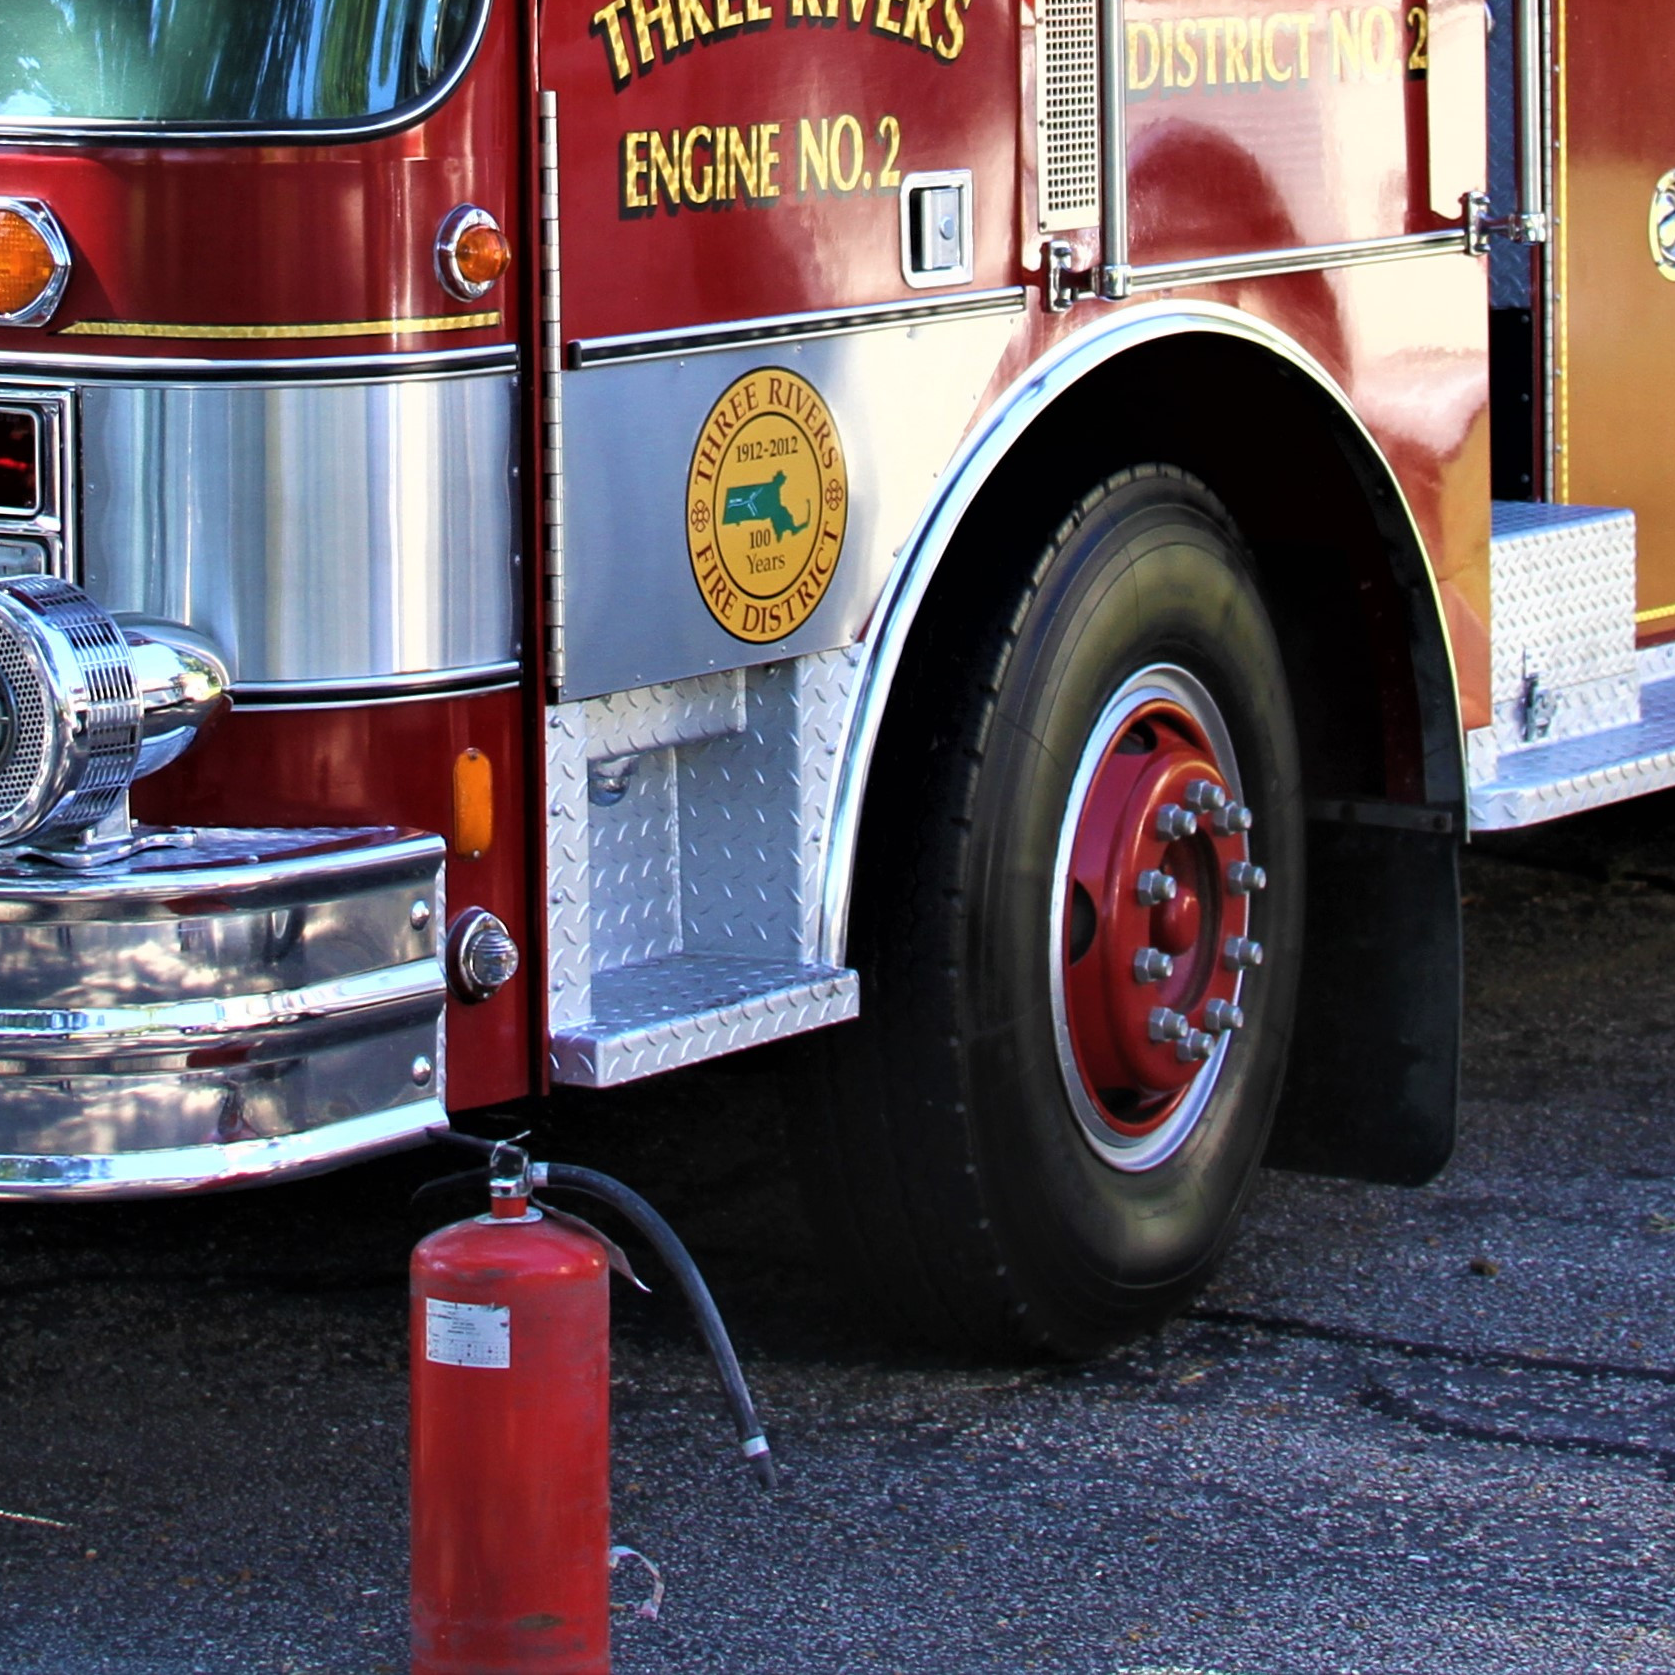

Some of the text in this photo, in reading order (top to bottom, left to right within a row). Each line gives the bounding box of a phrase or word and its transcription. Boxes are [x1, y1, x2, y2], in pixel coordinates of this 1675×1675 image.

[1127, 11, 1316, 92] DISTRICT
[624, 123, 781, 210] ENGINE
[694, 376, 840, 486] THREE RIVERS
[735, 435, 799, 464] 1912-2012
[695, 520, 840, 634] FIRE DISTRICT
[745, 552, 786, 575] Years
[748, 528, 771, 550] 100
